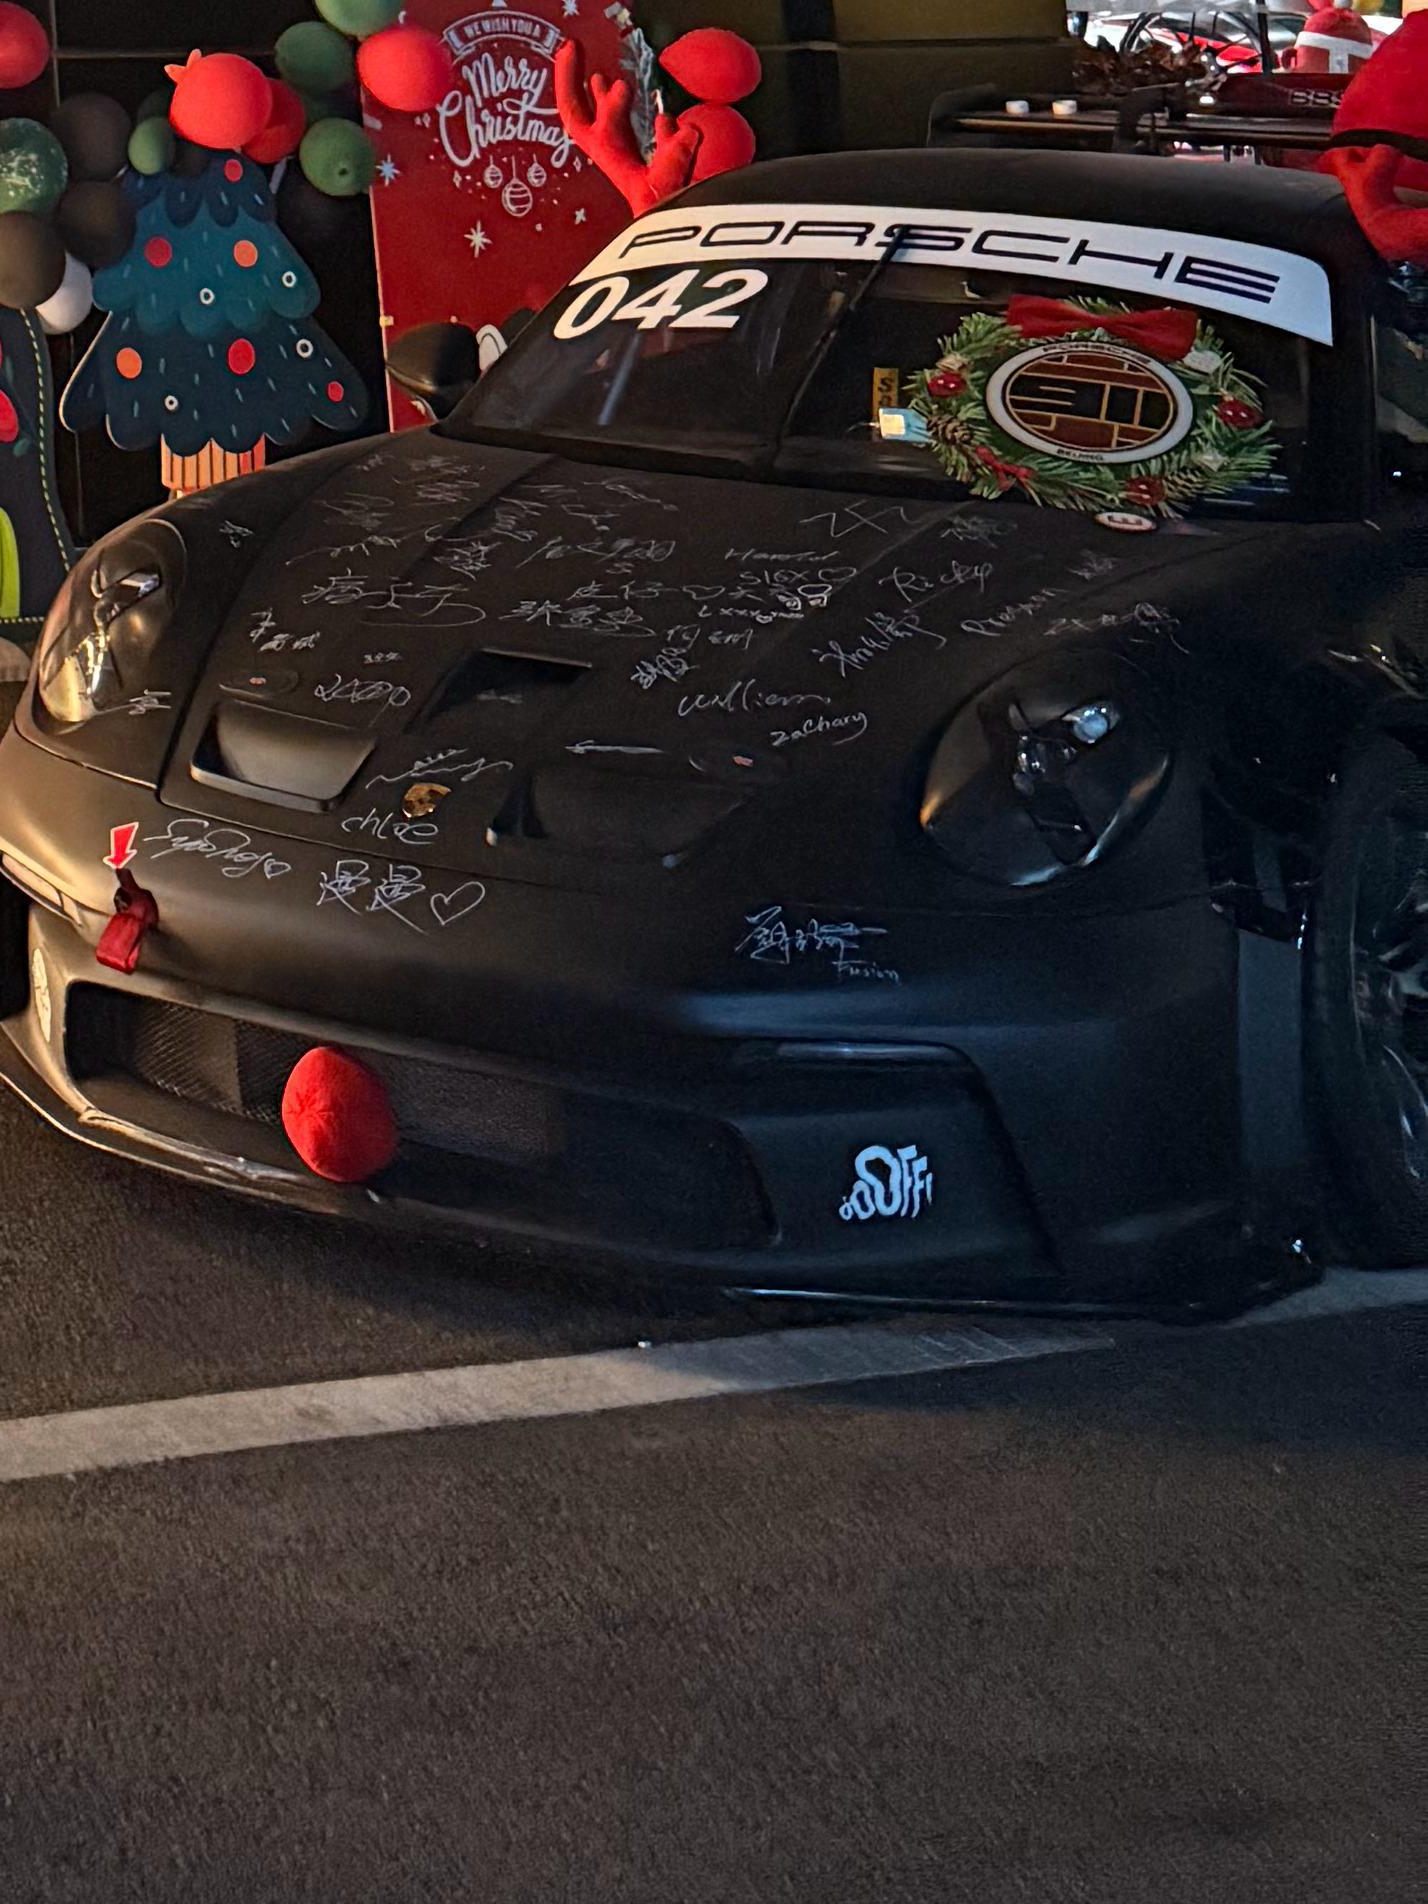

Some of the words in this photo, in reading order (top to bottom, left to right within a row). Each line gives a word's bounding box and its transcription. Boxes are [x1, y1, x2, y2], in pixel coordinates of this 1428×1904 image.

[463, 21, 482, 39] WE
[482, 18, 511, 34] WISH
[511, 19, 532, 35] YOU
[533, 24, 541, 39] A
[462, 52, 547, 108] Merry
[436, 90, 574, 169] Christmas
[619, 221, 1280, 304] PORSCHE
[553, 268, 770, 339] 042
